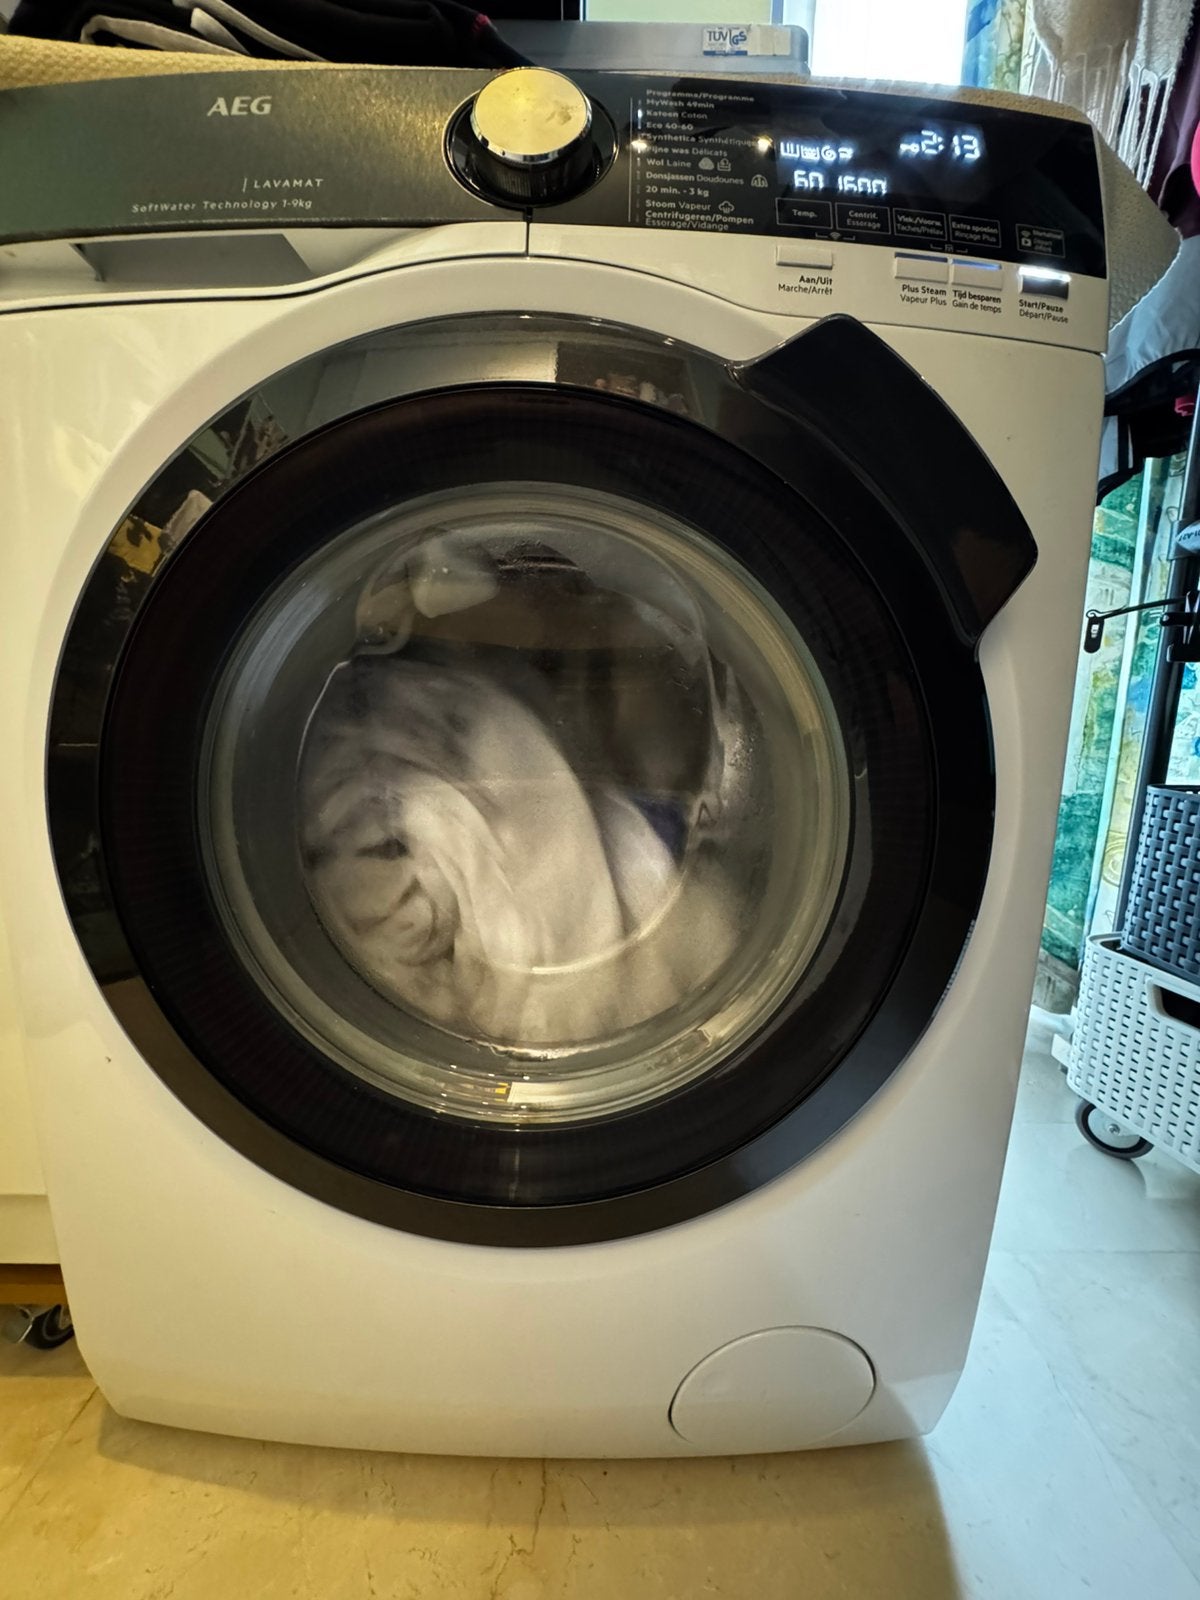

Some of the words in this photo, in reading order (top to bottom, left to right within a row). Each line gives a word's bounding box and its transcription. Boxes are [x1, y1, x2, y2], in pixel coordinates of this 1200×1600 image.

[206, 96, 273, 117] AEG
[646, 98, 685, 108] MyWash
[646, 109, 679, 118] Katoen
[680, 111, 708, 120] Coton
[646, 121, 663, 129] Eco
[665, 122, 694, 131] 40-60
[921, 129, 981, 160] 2:13
[692, 147, 728, 157] Délicats
[646, 157, 664, 166] Wol
[666, 158, 692, 168] Laine
[253, 178, 325, 190] LAVAMAT
[646, 171, 695, 183] Donsjassen
[696, 174, 744, 185] Doudounes
[645, 185, 658, 194] 20
[660, 186, 681, 194] min.
[697, 187, 710, 197] kg
[131, 203, 197, 214] SoftWater
[203, 199, 278, 211] Technology
[282, 199, 313, 210] 1-9kg
[645, 199, 676, 208] Stoom
[678, 201, 712, 211] Vapeur
[645, 210, 755, 225] Centrifugeren/Pompen
[792, 209, 818, 218] Temp.
[645, 218, 730, 231] Essorage/Vidange
[846, 218, 882, 229] Essorage
[952, 221, 971, 231] Extra
[955, 230, 981, 242] Rinçage
[982, 234, 998, 243] Plus
[799, 274, 833, 286] Aan/Uit
[778, 283, 833, 296] Marche/Arrêt
[902, 283, 919, 294] Plus
[921, 285, 947, 297] Steam
[900, 294, 928, 306] Vapeur
[930, 297, 948, 307] Plus
[953, 290, 967, 301] Tijd
[968, 290, 1002, 305] besparen
[952, 299, 969, 310] Gain
[969, 303, 979, 311] de
[980, 303, 1002, 315] temps
[1019, 298, 1064, 314] Start/Pauze
[1019, 308, 1069, 324] Départ/Pause
